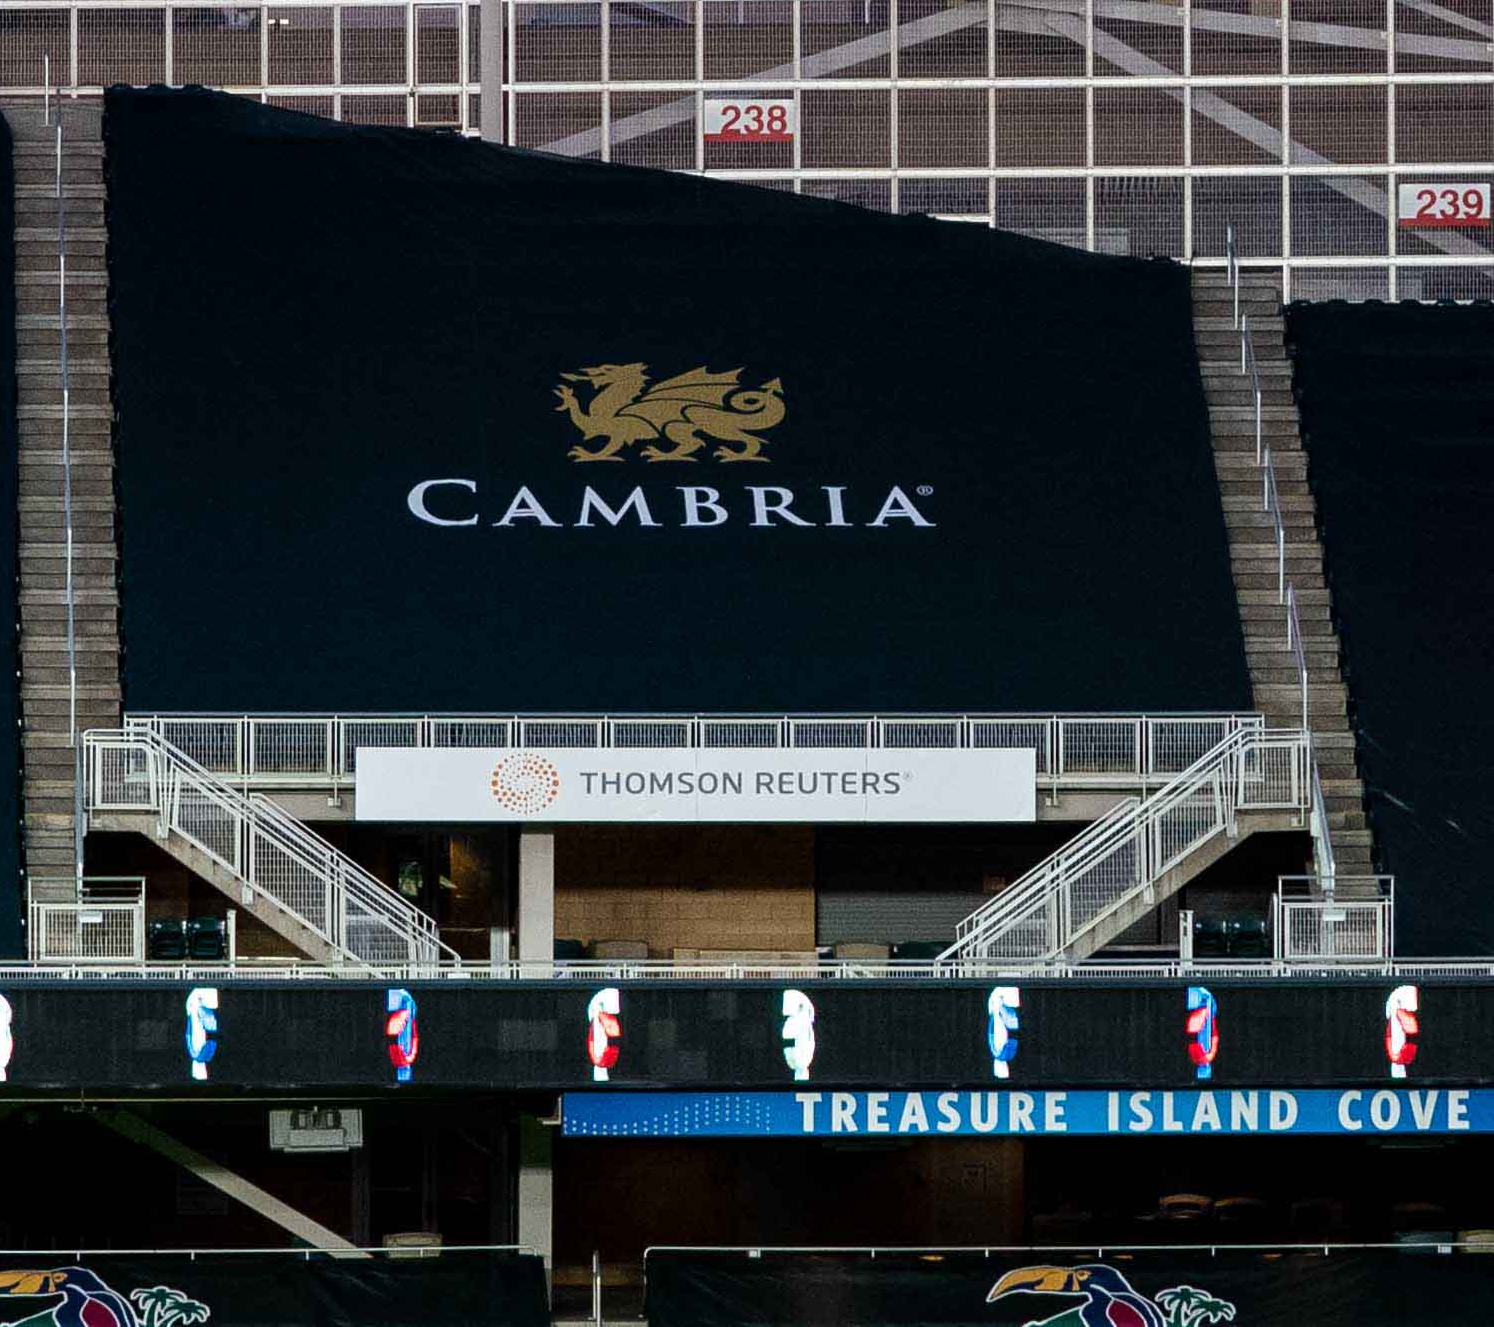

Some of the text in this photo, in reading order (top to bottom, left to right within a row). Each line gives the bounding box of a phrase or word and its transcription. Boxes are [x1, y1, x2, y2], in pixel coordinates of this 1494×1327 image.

[720, 104, 788, 135] 238
[1416, 189, 1484, 220] 239
[581, 772, 743, 795] THOMSON
[796, 1088, 1472, 1133] TREASURE ISLAND COVE
